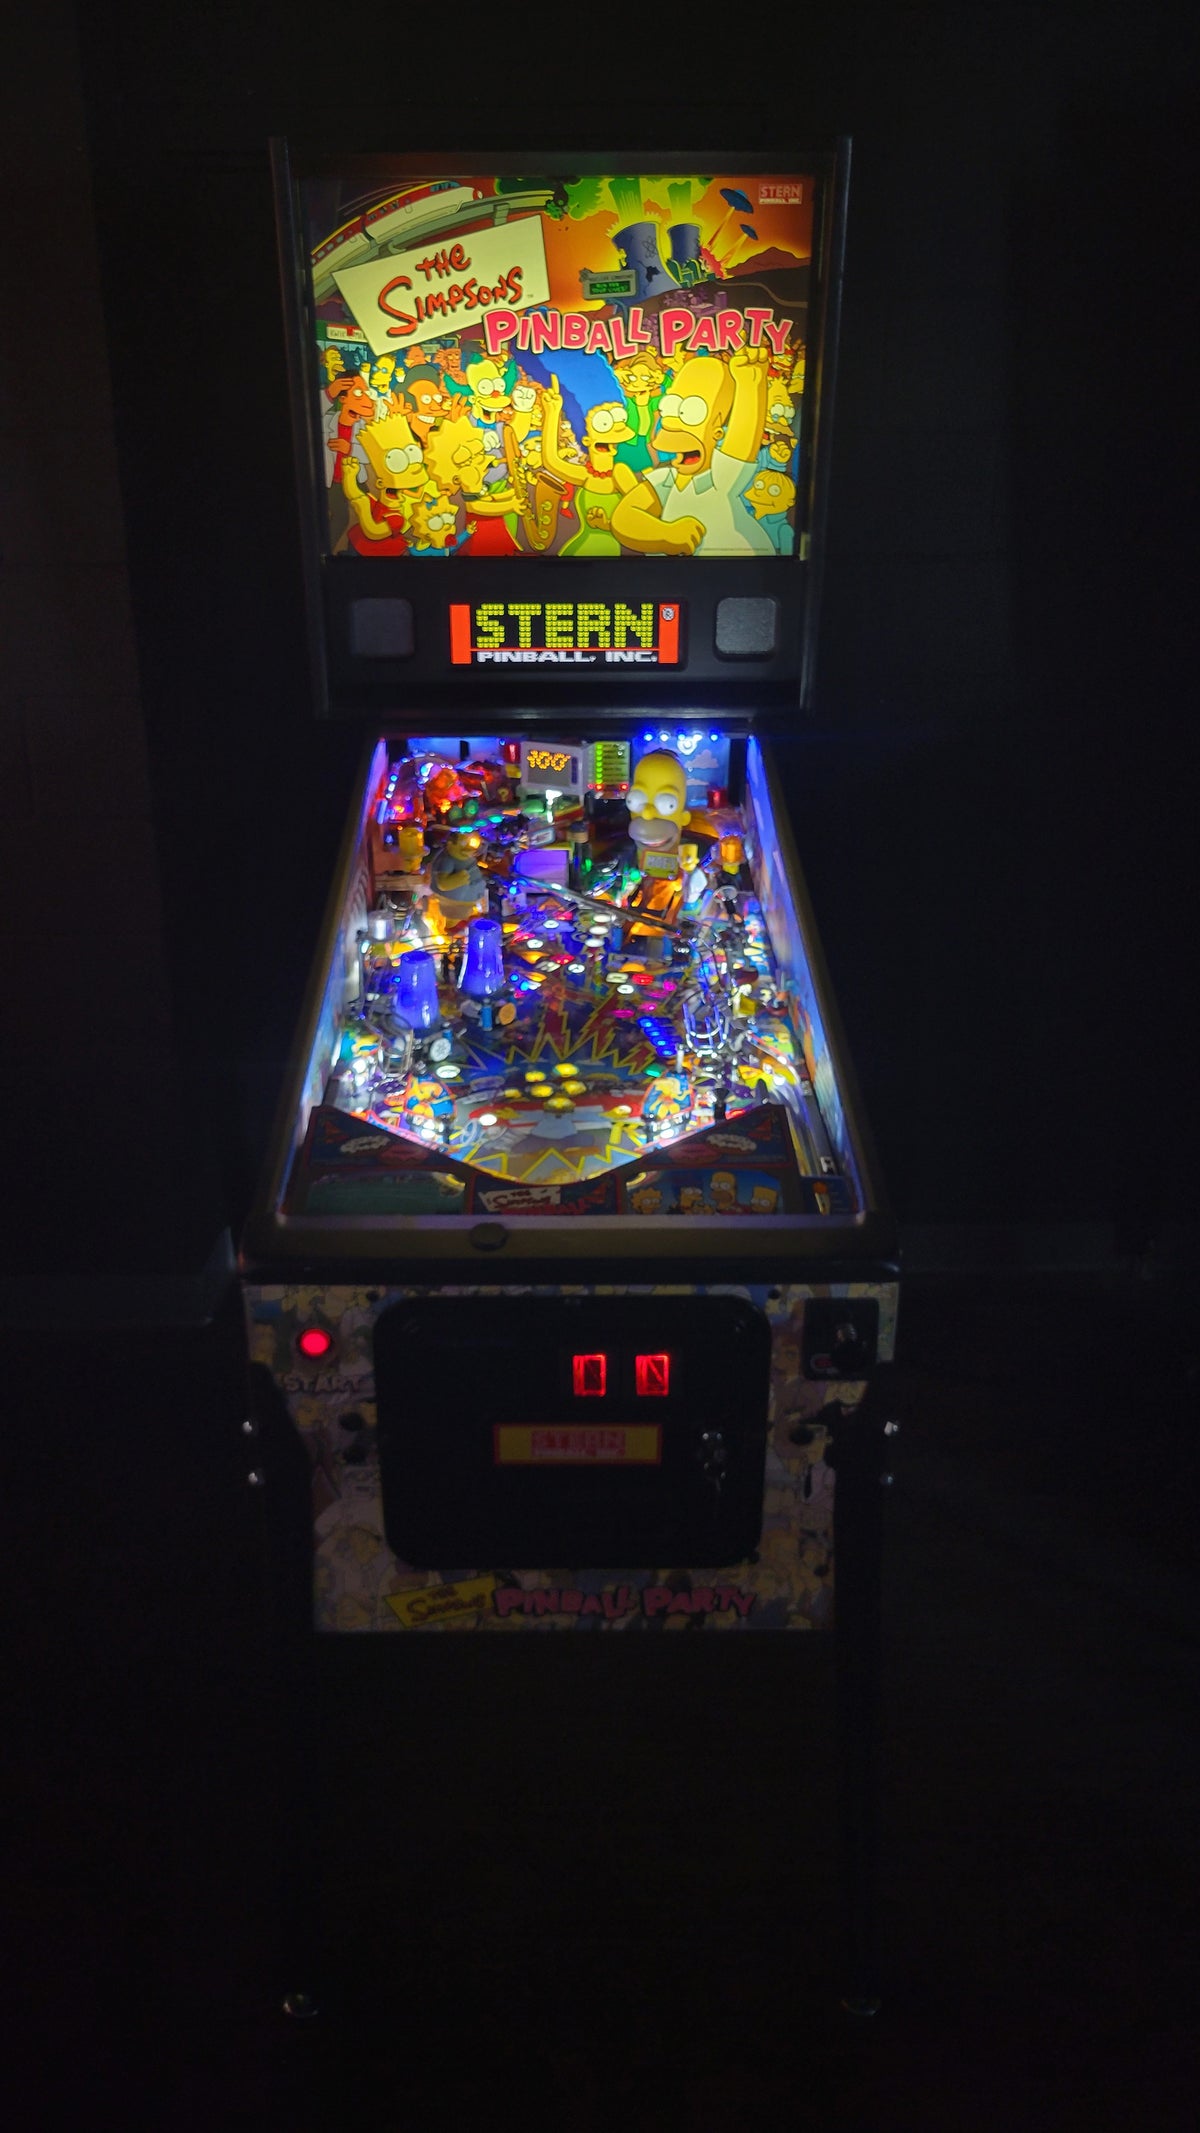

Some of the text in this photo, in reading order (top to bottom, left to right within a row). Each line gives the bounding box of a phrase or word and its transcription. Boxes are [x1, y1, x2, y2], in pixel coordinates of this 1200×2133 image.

[760, 186, 801, 198] STERN
[378, 266, 523, 337] SIMPSONS
[482, 307, 795, 361] PINBALL PARTY
[475, 603, 654, 649] STERN
[605, 651, 659, 664] INC.
[282, 1374, 363, 1392] START
[495, 1586, 756, 1618] PINBALL PARTY
